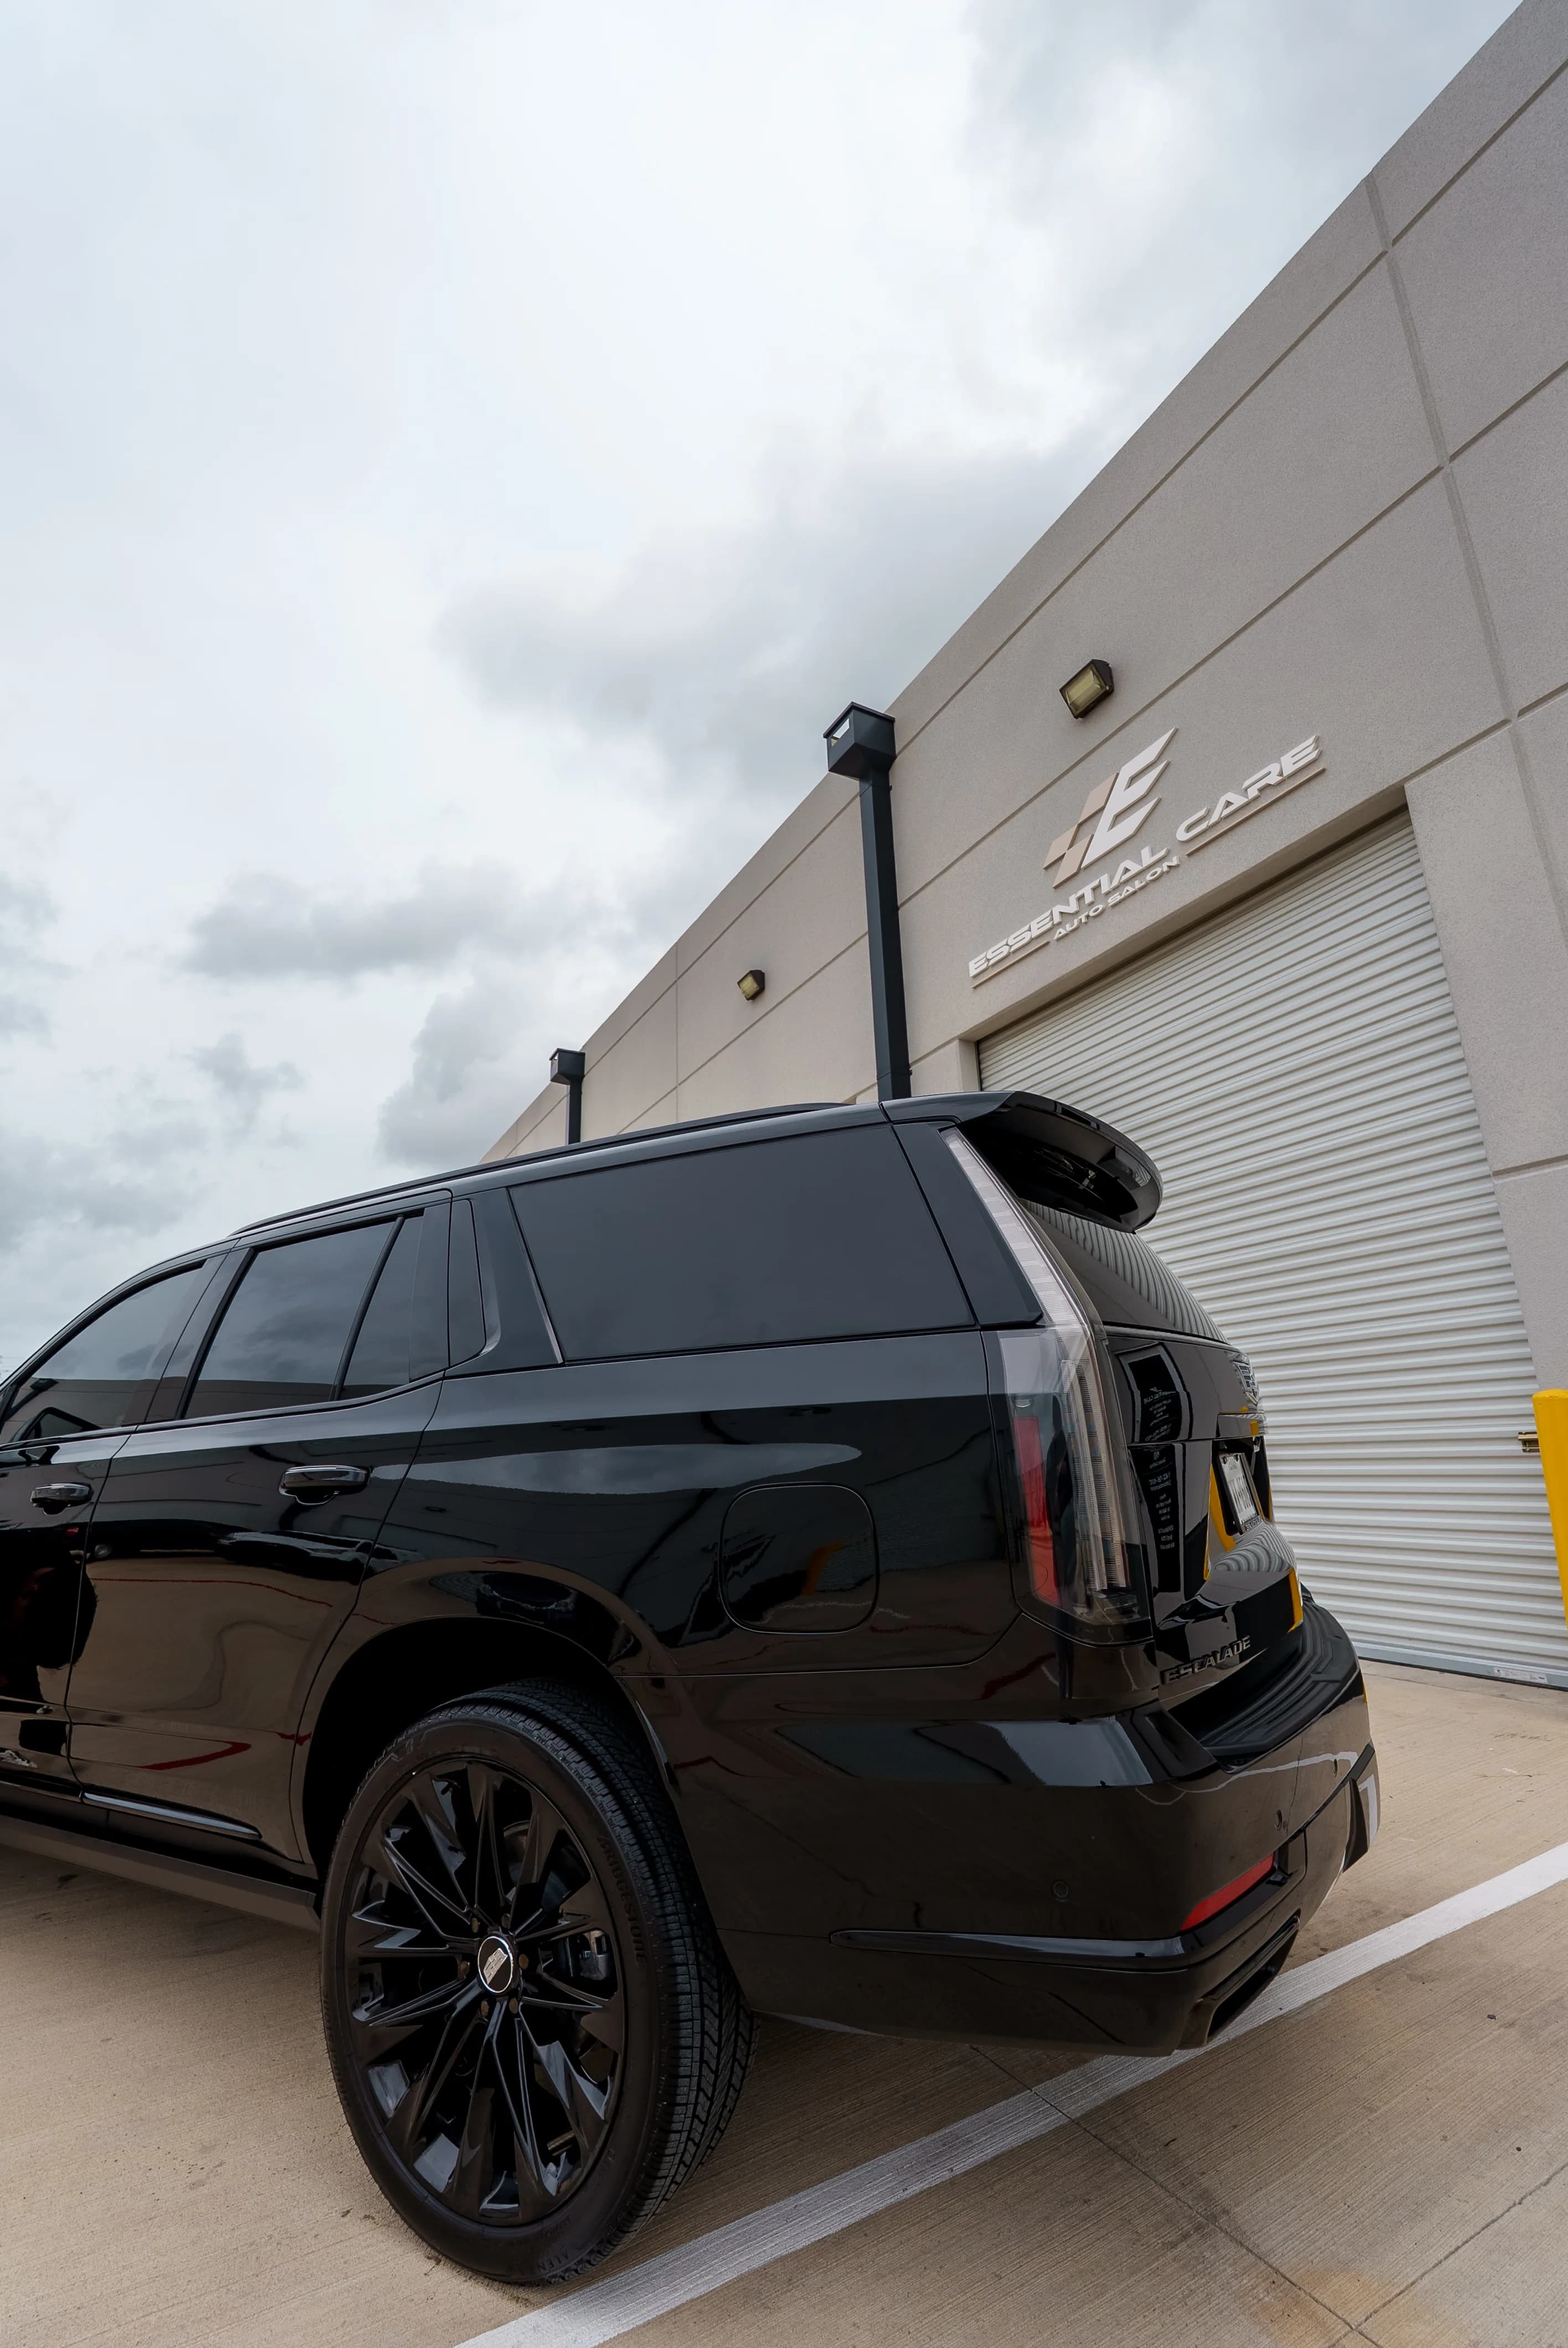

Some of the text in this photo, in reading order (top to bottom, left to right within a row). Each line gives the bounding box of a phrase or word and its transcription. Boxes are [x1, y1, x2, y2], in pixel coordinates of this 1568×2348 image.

[968, 734, 1322, 979] ESSENTIAL CARE
[1054, 855, 1180, 941] AUTO SALON
[1160, 1635, 1251, 1685] ESCALADE
